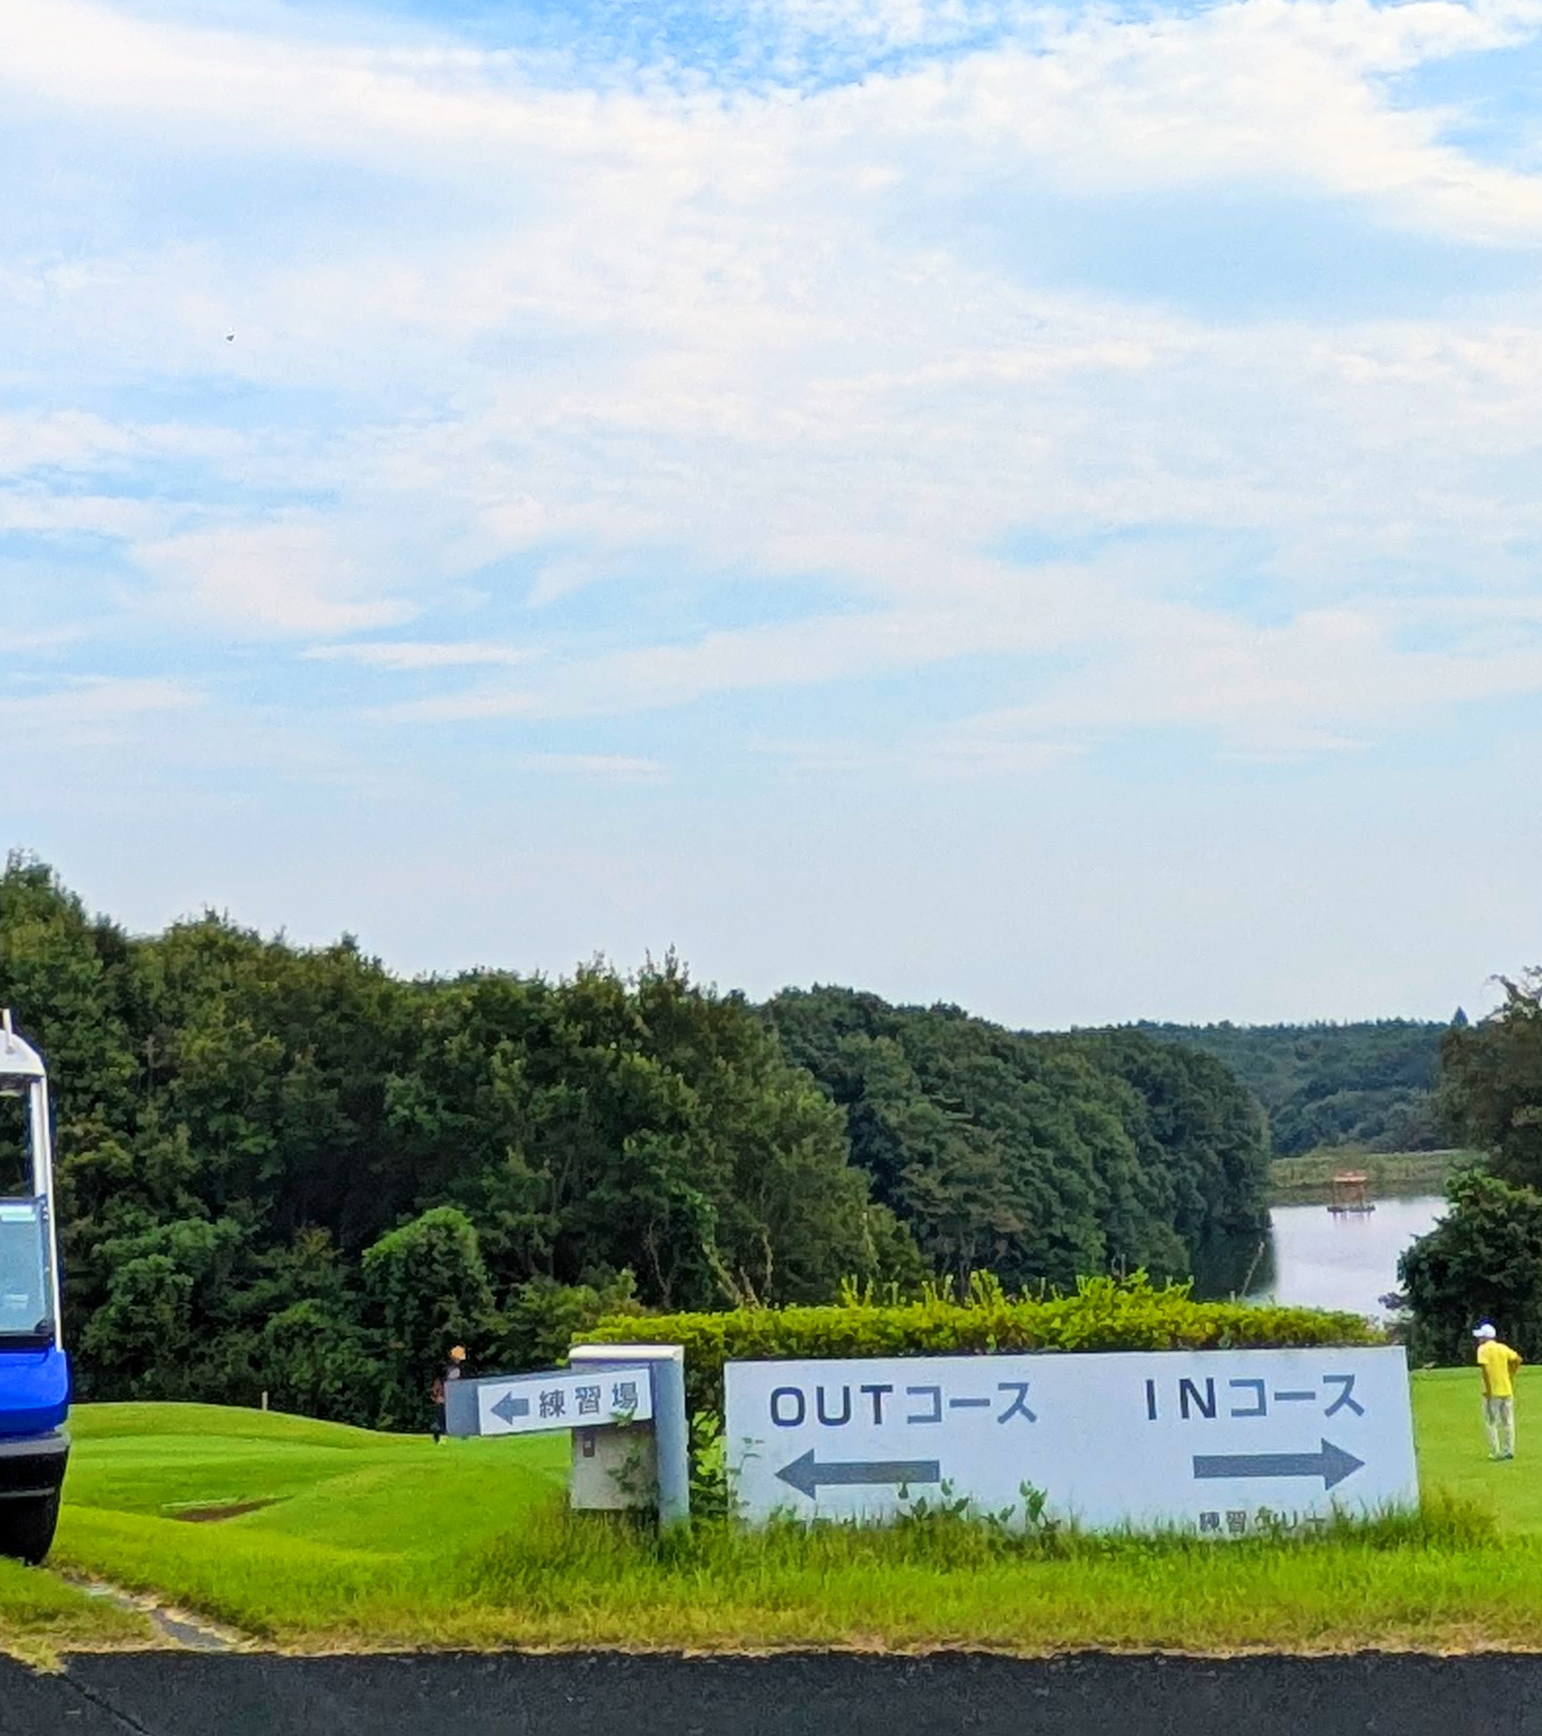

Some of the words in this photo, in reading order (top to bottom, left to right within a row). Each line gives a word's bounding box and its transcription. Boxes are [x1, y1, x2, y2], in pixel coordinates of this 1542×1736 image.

[539, 1381, 639, 1418] 練習場
[770, 1382, 1037, 1427] OUTコース
[1146, 1373, 1365, 1420] INコース
[1199, 1507, 1354, 1535] 練習グリー
